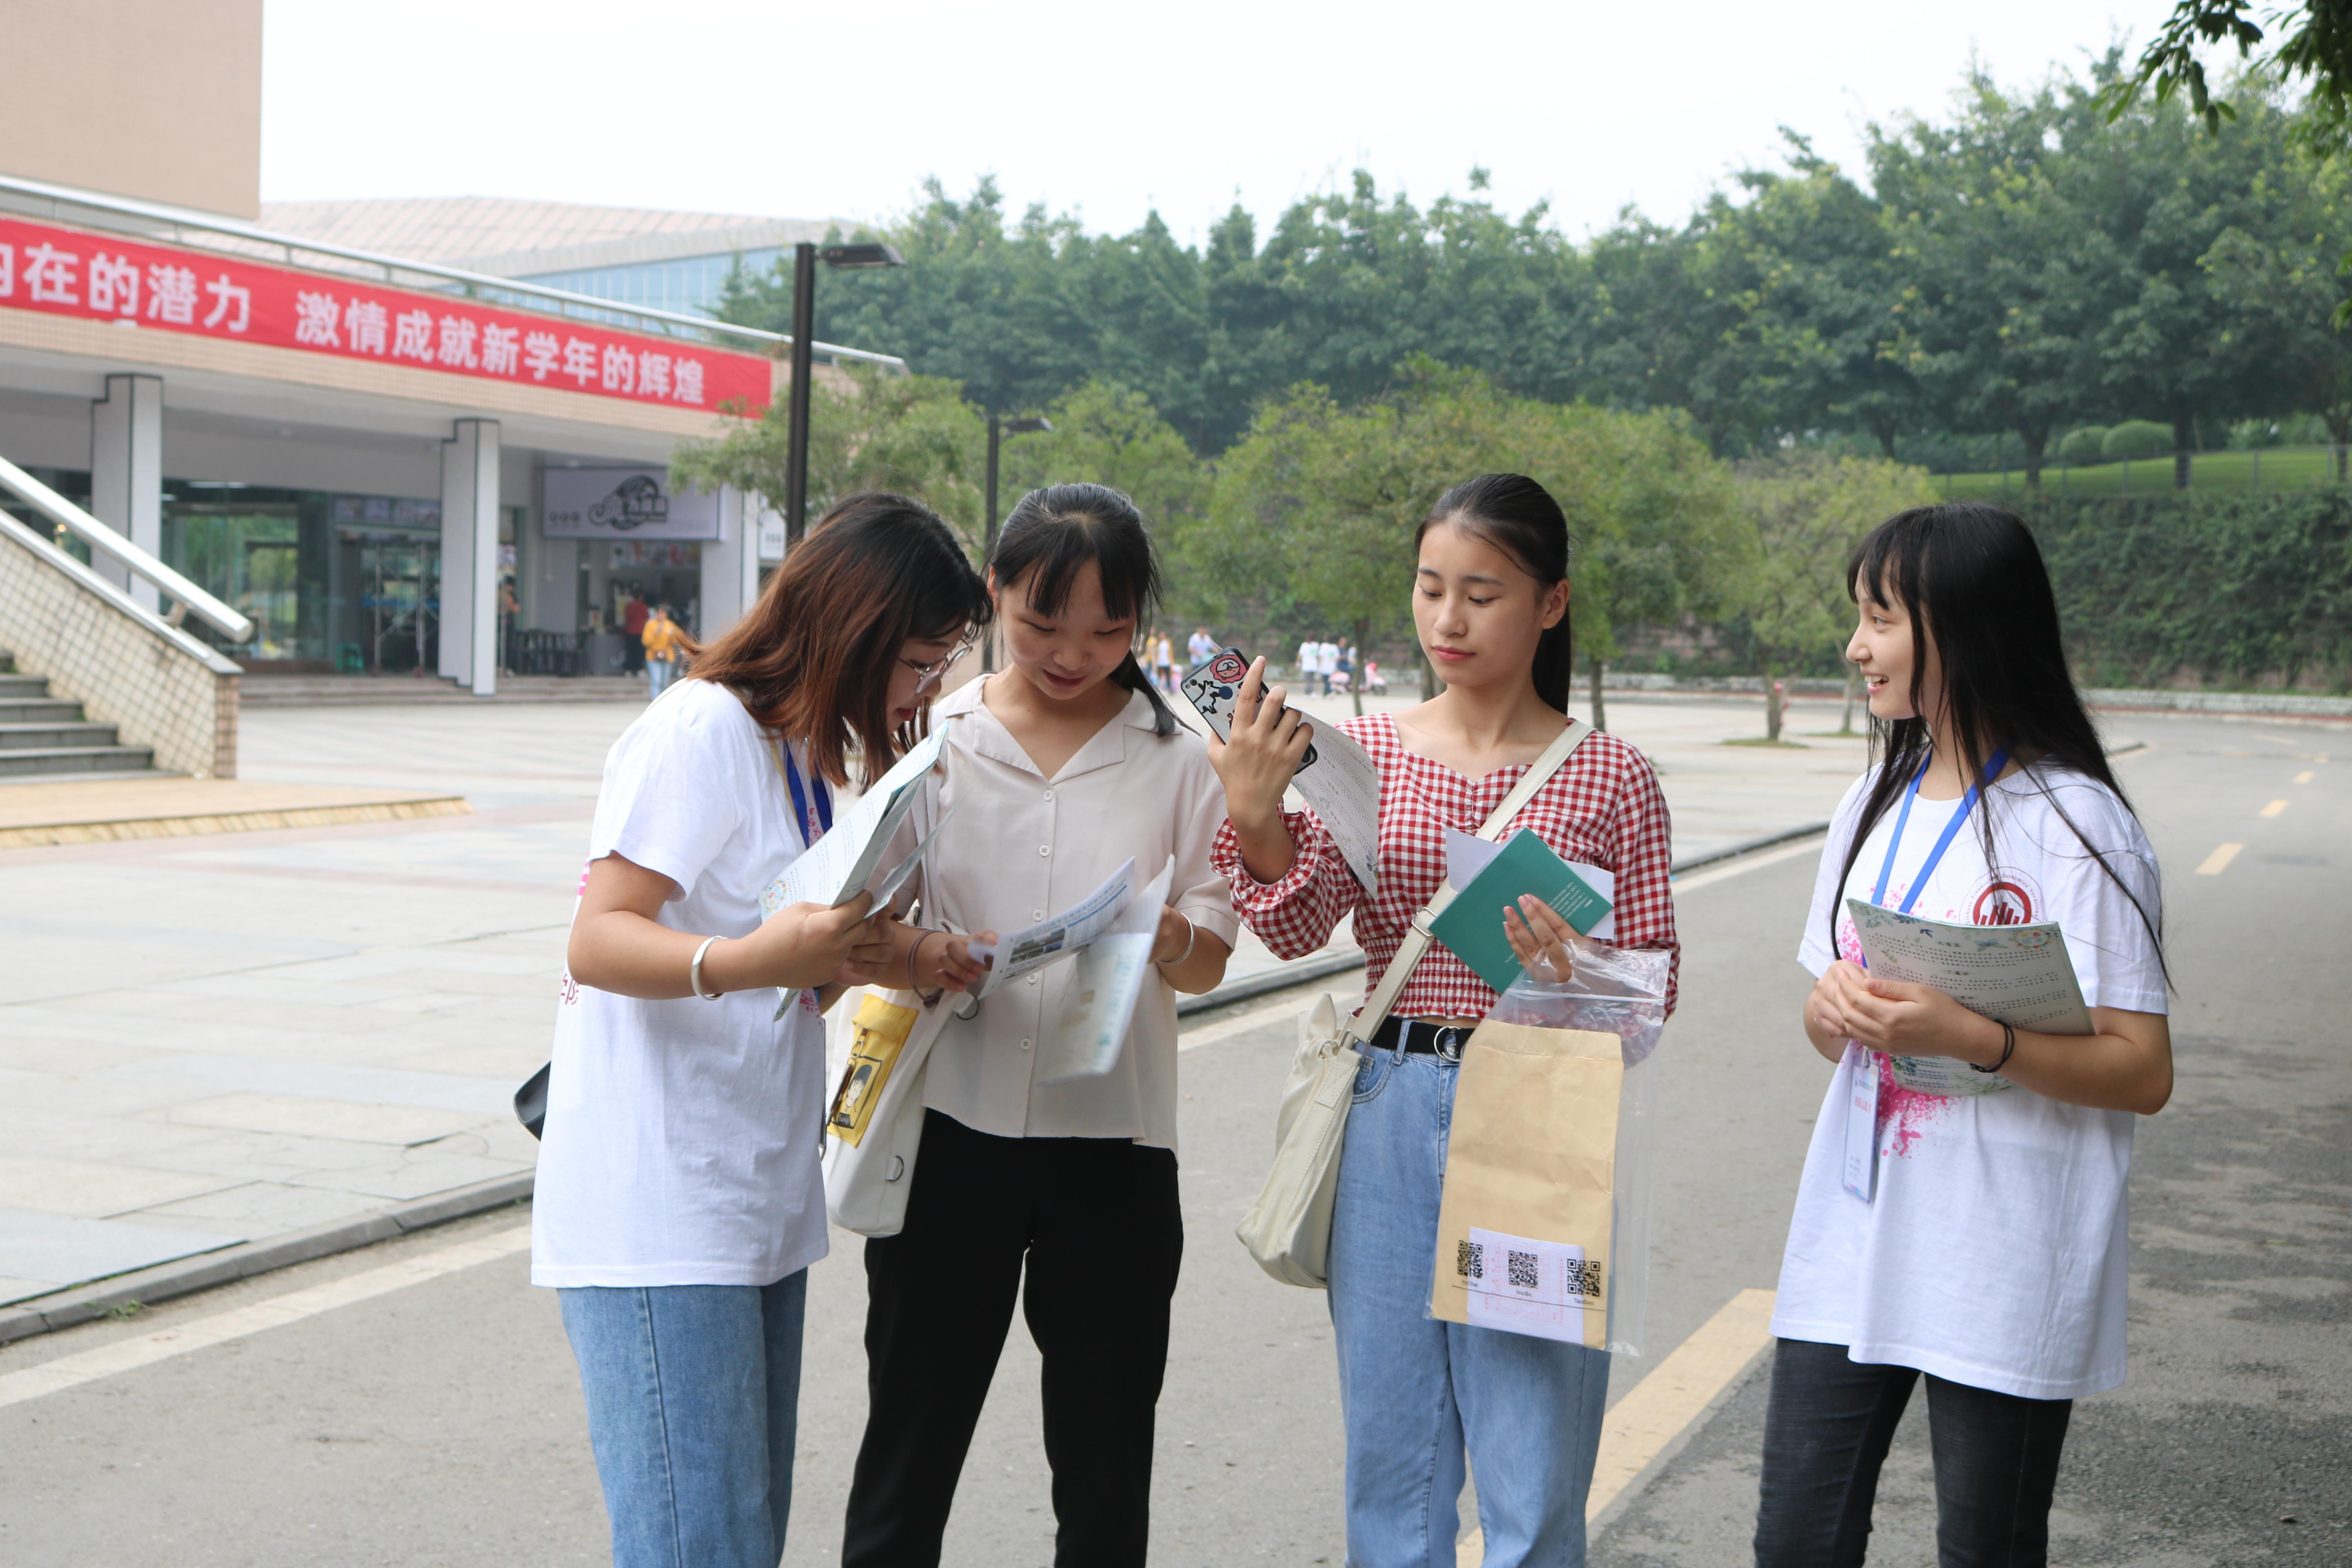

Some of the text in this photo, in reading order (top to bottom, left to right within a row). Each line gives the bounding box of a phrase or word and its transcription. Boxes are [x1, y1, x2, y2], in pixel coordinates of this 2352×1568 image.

[295, 290, 704, 404] 激情成就新学年的辉煌
[2030, 888, 2039, 919] Vocationa
